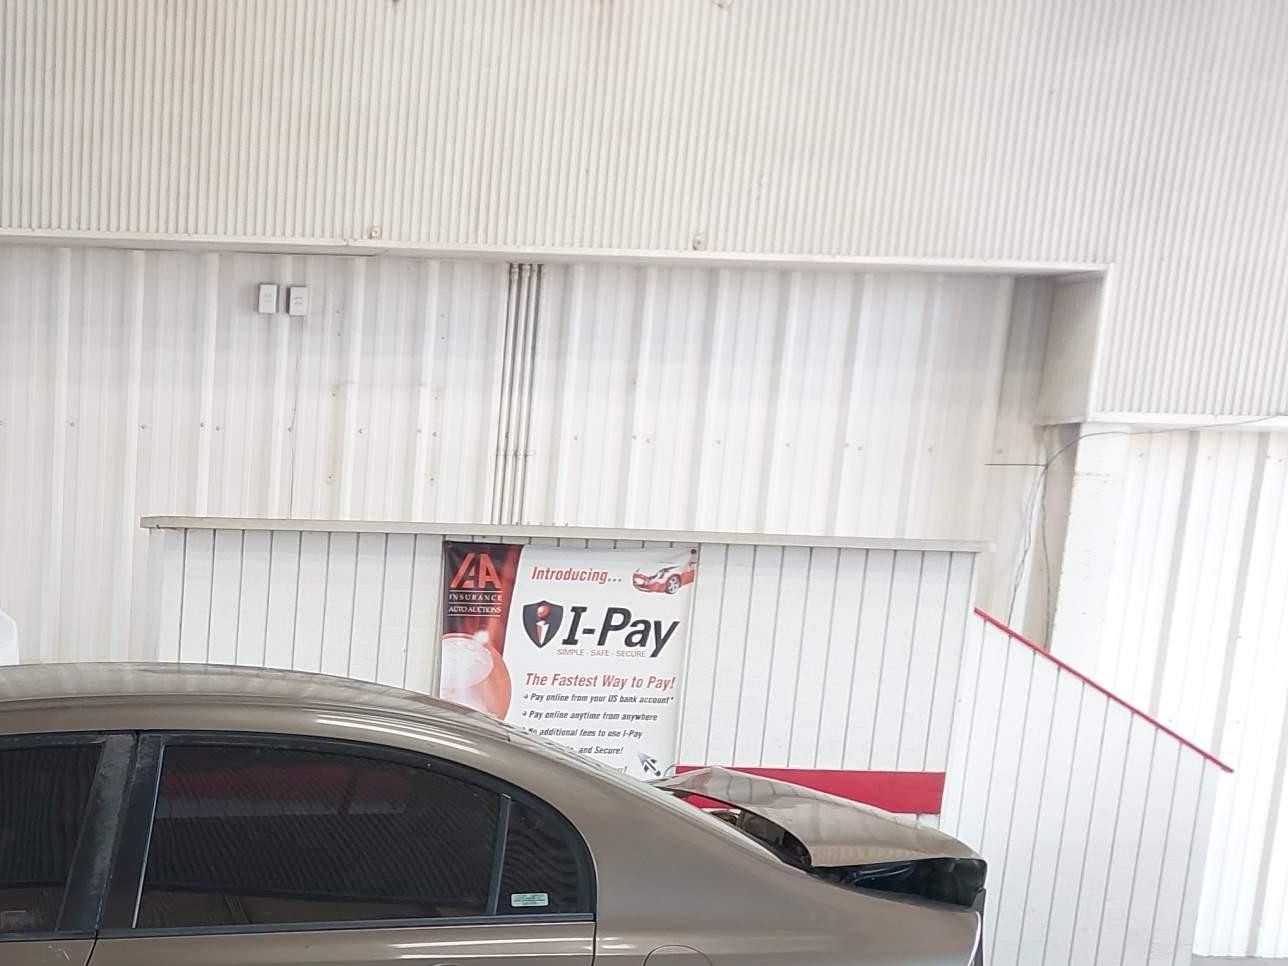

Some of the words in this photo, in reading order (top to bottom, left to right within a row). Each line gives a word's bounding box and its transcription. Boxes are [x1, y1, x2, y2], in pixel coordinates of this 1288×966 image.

[531, 567, 622, 584] Introducing...
[448, 593, 502, 601] INSURANCE
[562, 606, 680, 658] I-Pay
[556, 648, 585, 656] SIMPLE
[590, 649, 610, 657] SAFE
[615, 650, 647, 658] SECURE
[525, 673, 548, 686] The
[551, 673, 598, 687] Fastest
[602, 674, 628, 690] Way
[631, 675, 643, 688] to
[647, 675, 676, 691] Pay!
[530, 693, 545, 702] Pay
[545, 693, 569, 701] online
[571, 693, 588, 702] from
[590, 695, 606, 703] your
[608, 694, 618, 702] US
[619, 695, 637, 703] bank
[528, 710, 543, 720] Pay
[544, 711, 569, 719] online
[569, 712, 601, 720] anytime
[602, 712, 620, 720] from
[621, 713, 658, 722] anywhere
[539, 728, 578, 736] additional
[579, 729, 596, 737] fees
[598, 729, 606, 737] to
[622, 729, 643, 739] I-Pay
[578, 746, 593, 754] and
[594, 746, 624, 755] Secure!
